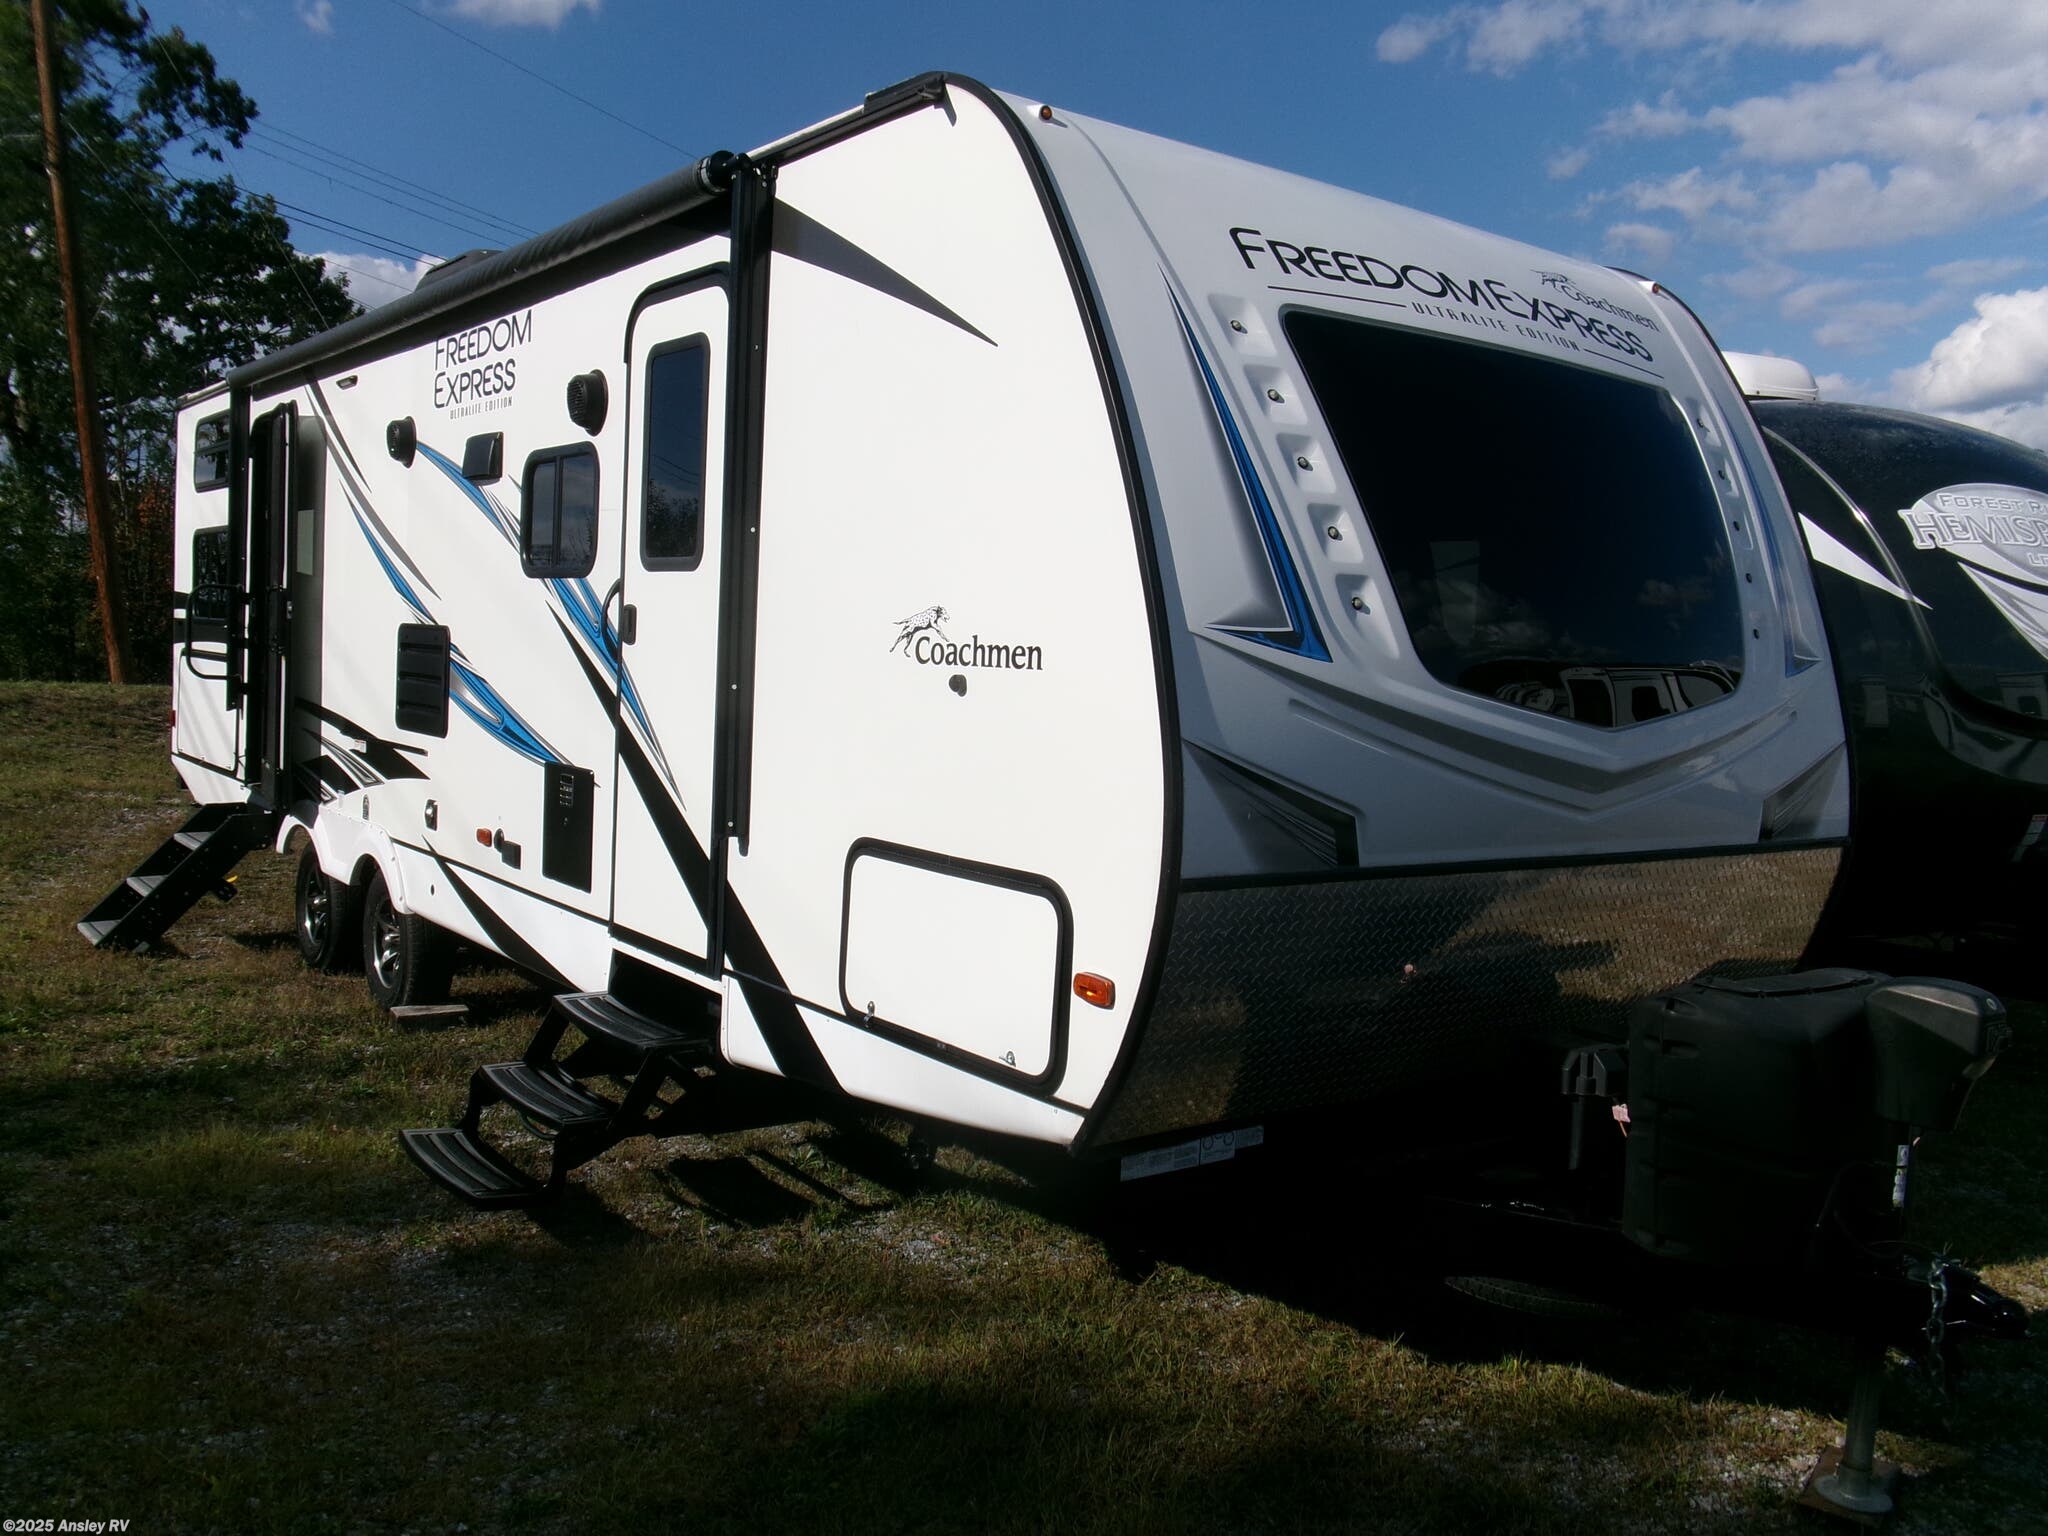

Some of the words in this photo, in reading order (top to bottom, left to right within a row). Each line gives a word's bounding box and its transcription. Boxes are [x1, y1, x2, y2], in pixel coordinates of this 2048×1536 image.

[1413, 302, 1506, 332] ULTRALITE
[1561, 285, 1660, 332] Coachmen
[435, 309, 532, 371] FREEDOM
[1516, 327, 1580, 351] EDITION
[434, 358, 516, 409] EXPRESS
[1937, 493, 2023, 511] FOREST
[915, 635, 1043, 670] Coachmen
